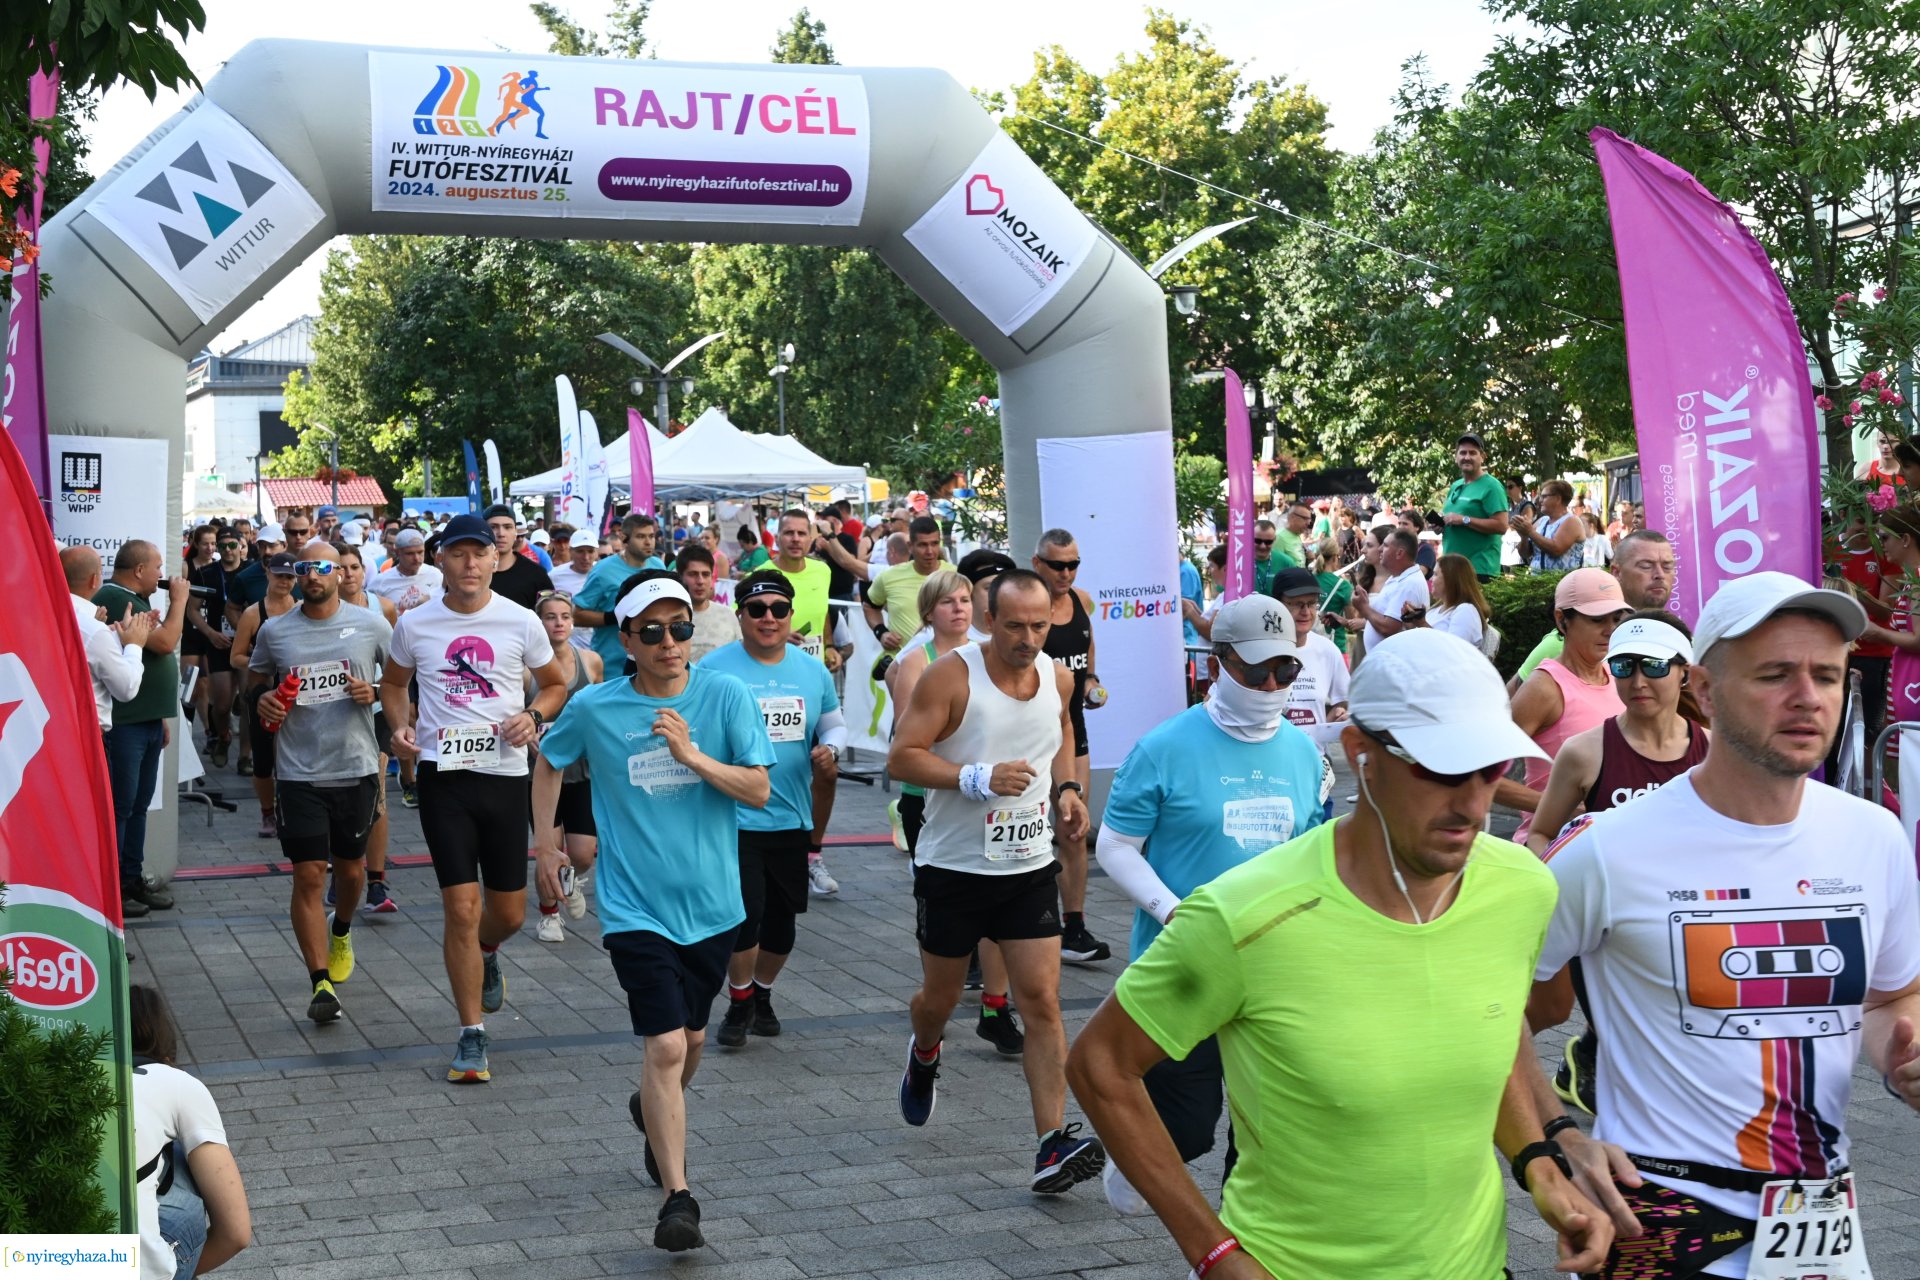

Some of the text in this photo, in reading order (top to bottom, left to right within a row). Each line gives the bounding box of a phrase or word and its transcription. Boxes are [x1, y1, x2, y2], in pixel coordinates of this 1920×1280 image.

[594, 87, 856, 135] RAJT/CÉL
[391, 142, 573, 163] IV. WITTUR-NYÍREGYHÁZI
[388, 159, 573, 186] FUTÓFESZTIVÁL
[388, 181, 571, 202] 2024. augusztus 25.
[611, 174, 840, 193] www.nyiregyhazifutofesztival.hu
[215, 217, 275, 272] WITTUR
[997, 207, 1065, 275] MOZAIK
[61, 493, 102, 503] SCOPE
[68, 503, 95, 513] WHP
[1099, 585, 1167, 599] NYÍREGYHÁZA
[1100, 598, 1161, 621] Többet
[299, 672, 348, 692] 21208
[442, 736, 495, 755] 21052
[991, 818, 1044, 842] 21009
[1667, 889, 1699, 901] 1958
[1711, 1229, 1743, 1243] Kodak
[1765, 1215, 1852, 1259] 21129
